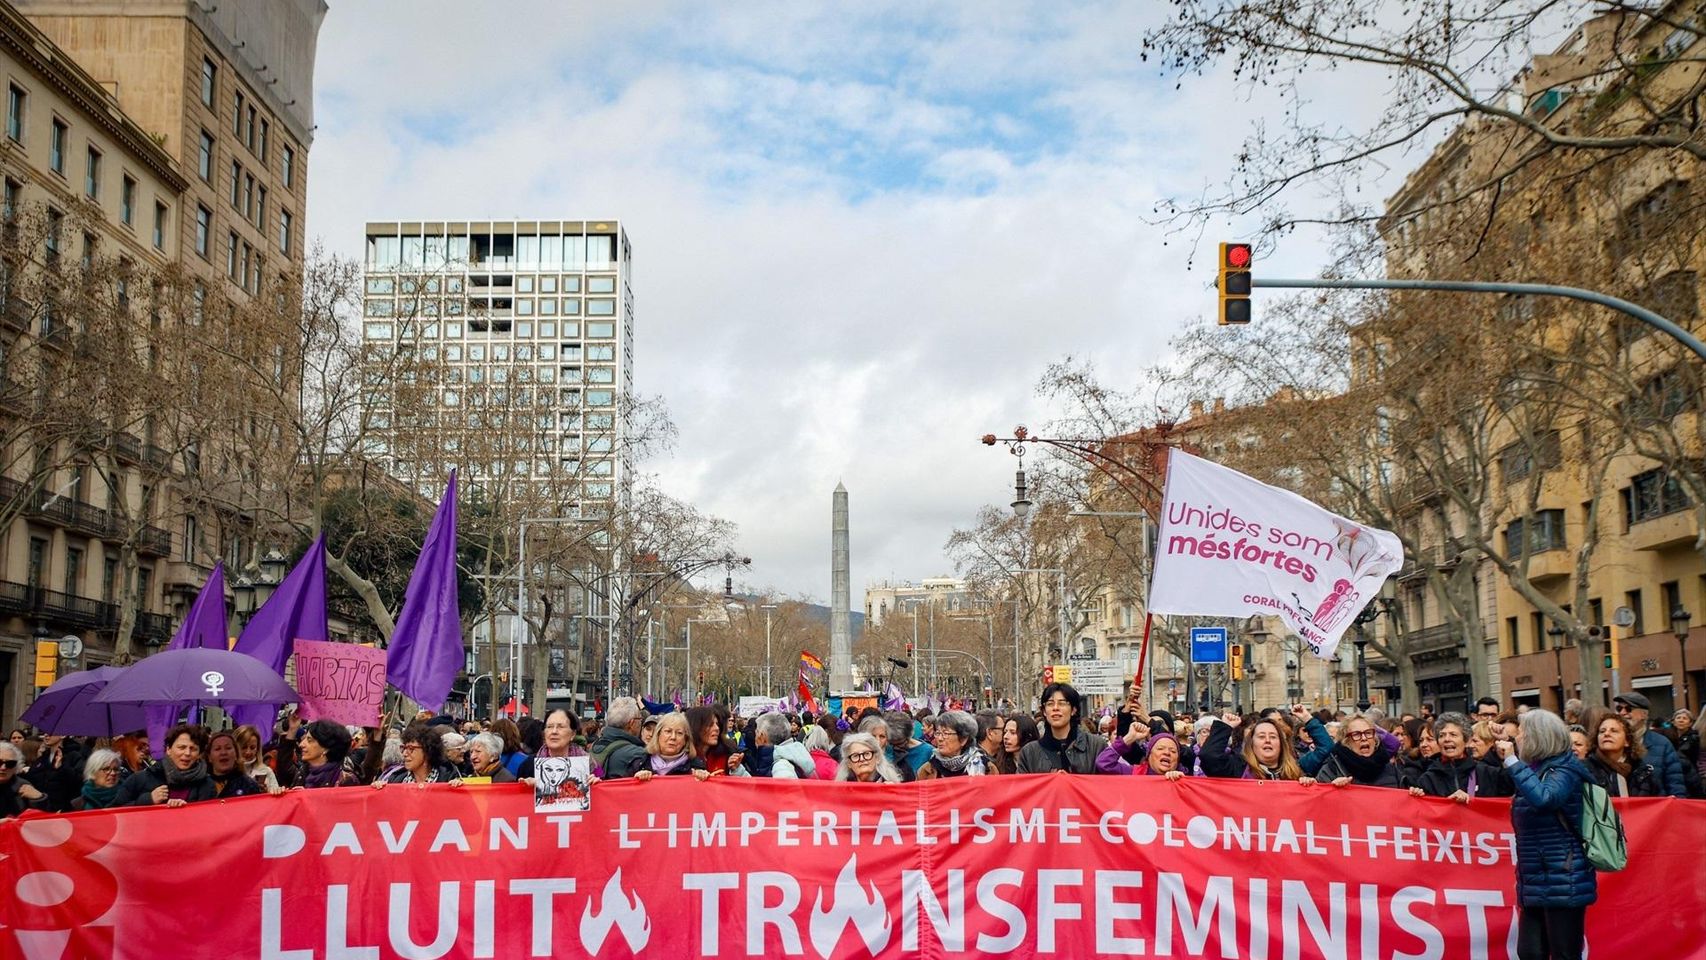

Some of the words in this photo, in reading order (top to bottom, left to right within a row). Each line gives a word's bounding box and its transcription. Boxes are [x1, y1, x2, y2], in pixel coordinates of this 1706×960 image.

[1168, 502, 1262, 537] Unides
[1267, 527, 1334, 561] som
[1243, 594, 1281, 610] CORAL
[293, 652, 386, 706] HARTAS
[263, 815, 583, 858] DAVANT
[617, 807, 1081, 849] L'IMPERIALISME
[1099, 811, 1328, 855] COLONIAL
[1341, 824, 1352, 857] I
[1367, 825, 1520, 867] FEIXIST
[682, 853, 1590, 960] TRANSFEMINIST
